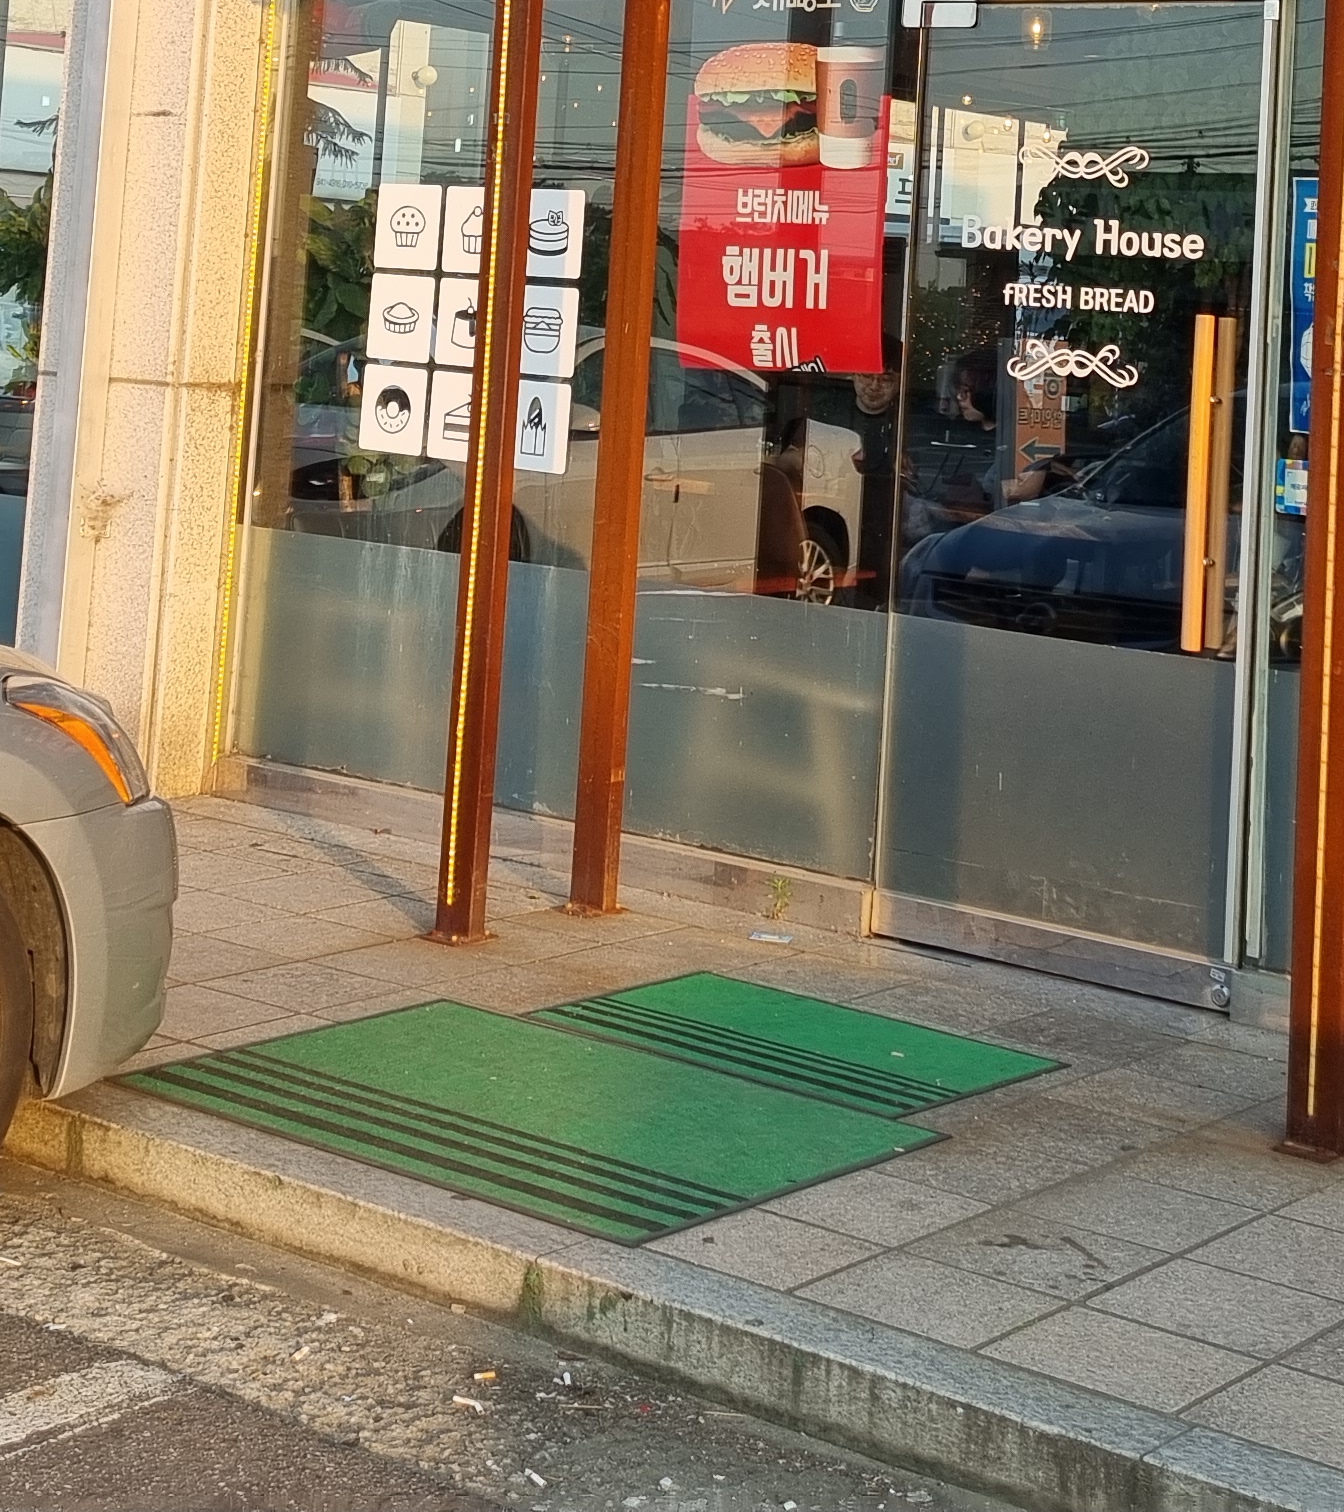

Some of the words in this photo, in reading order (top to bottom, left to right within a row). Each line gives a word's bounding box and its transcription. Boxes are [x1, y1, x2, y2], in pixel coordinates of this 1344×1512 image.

[735, 188, 830, 225] 브런치메뉴
[960, 214, 1082, 262] Bakery
[1093, 218, 1206, 260] House
[722, 245, 829, 310] 햄버거
[1079, 286, 1156, 314] BREAD
[750, 324, 800, 369] 출시
